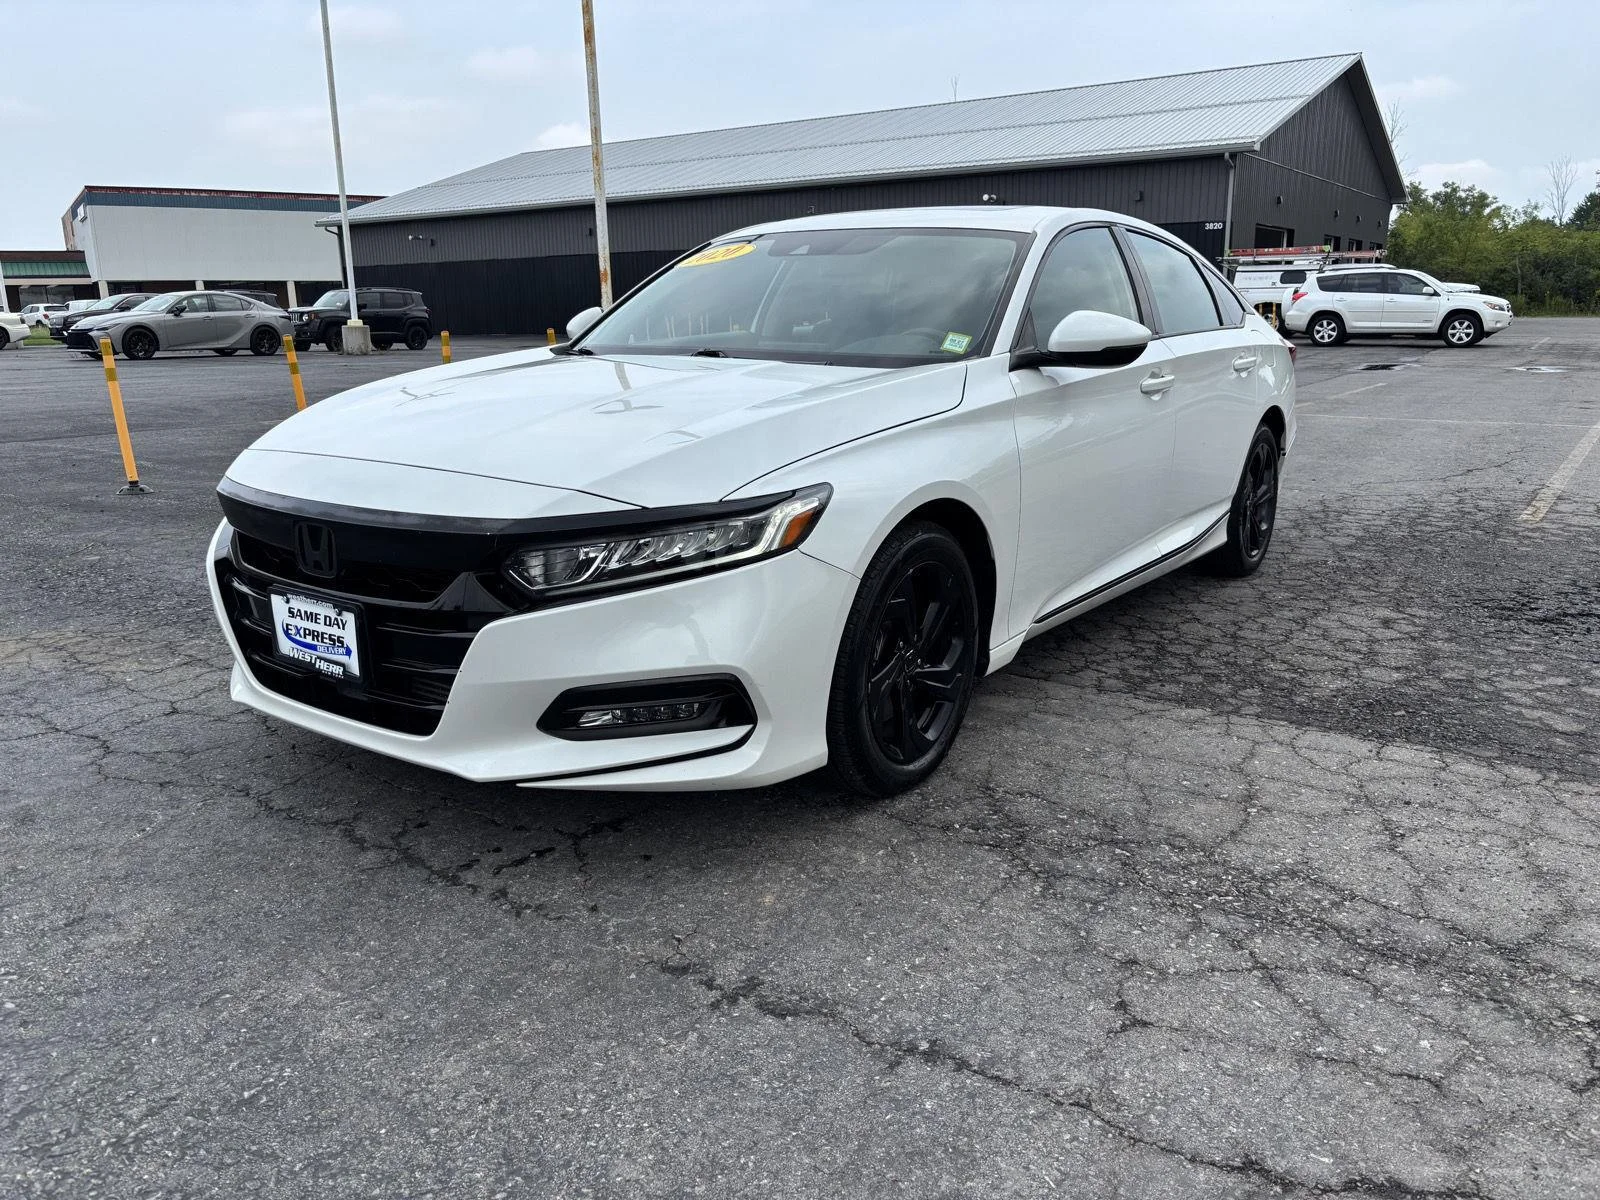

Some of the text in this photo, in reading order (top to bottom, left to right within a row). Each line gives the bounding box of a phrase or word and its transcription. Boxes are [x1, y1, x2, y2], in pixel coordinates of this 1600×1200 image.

[1204, 222, 1223, 230] 3820
[287, 606, 348, 631] SAME DAY
[285, 623, 345, 648] EXPRESS
[316, 645, 347, 655] DELIVERY
